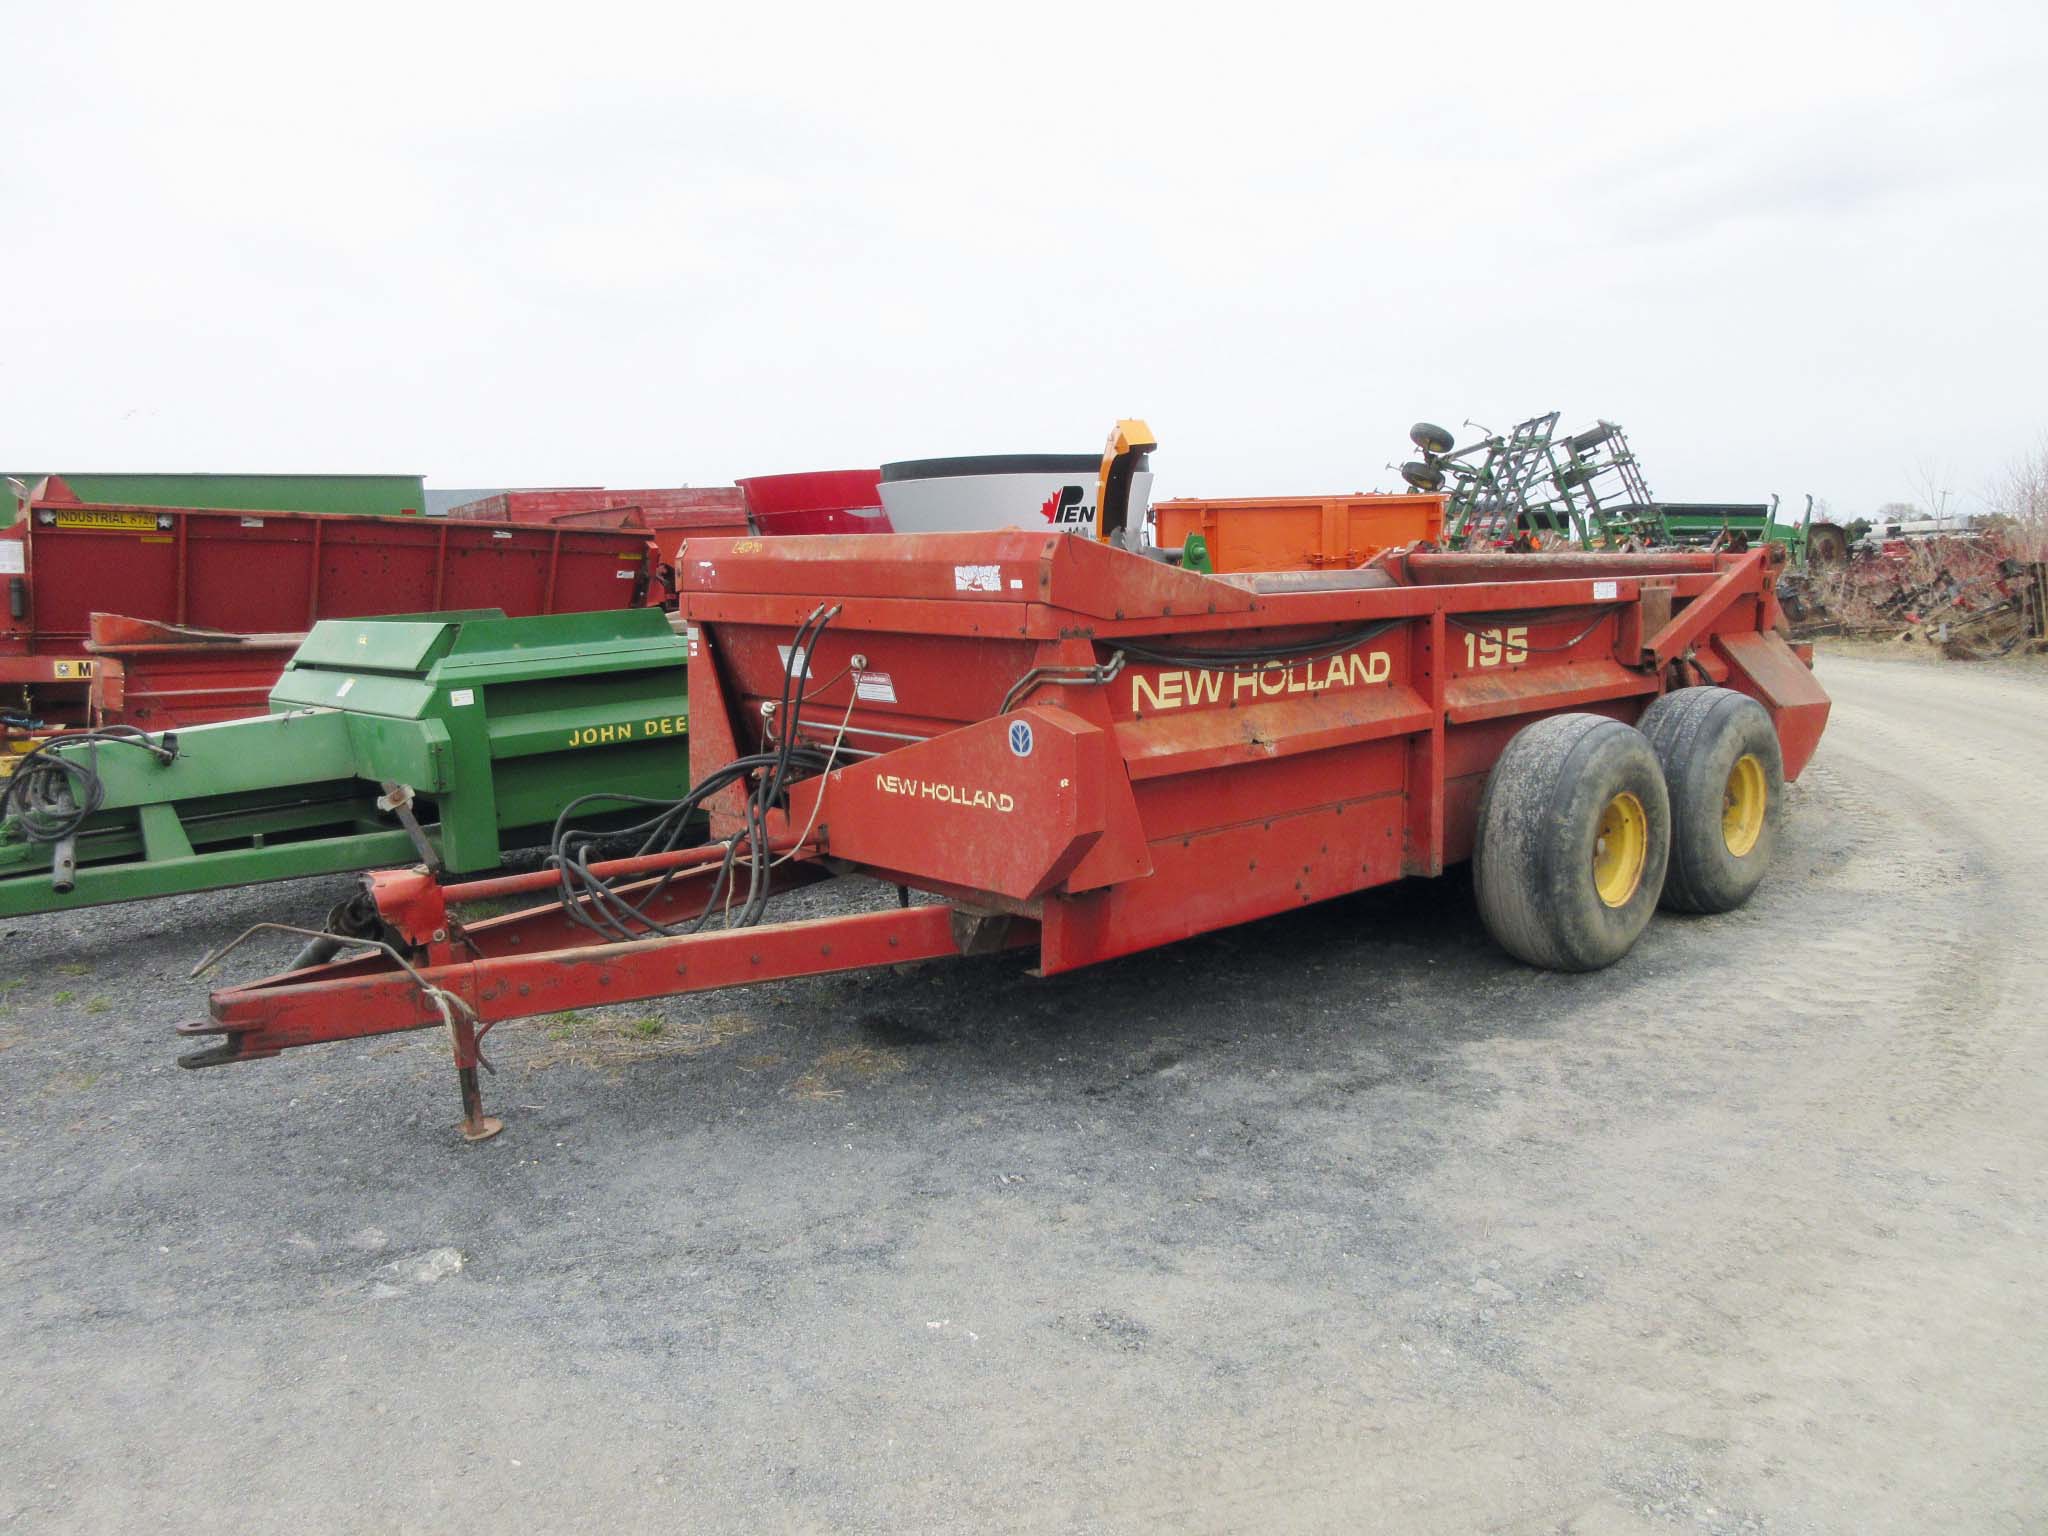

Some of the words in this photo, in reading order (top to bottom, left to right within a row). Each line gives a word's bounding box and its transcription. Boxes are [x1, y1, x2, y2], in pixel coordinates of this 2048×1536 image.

[56, 510, 127, 524] INDUSTRIAL
[1054, 485, 1096, 524] PEN
[1464, 627, 1529, 668] 195
[77, 662, 92, 677] M
[1132, 669, 1224, 712] NEW
[1233, 651, 1391, 700] HOLLAND
[568, 723, 632, 747] JOHN
[644, 716, 688, 736] DEE
[875, 773, 917, 797] NEW
[921, 781, 1014, 813] HOLLAND
